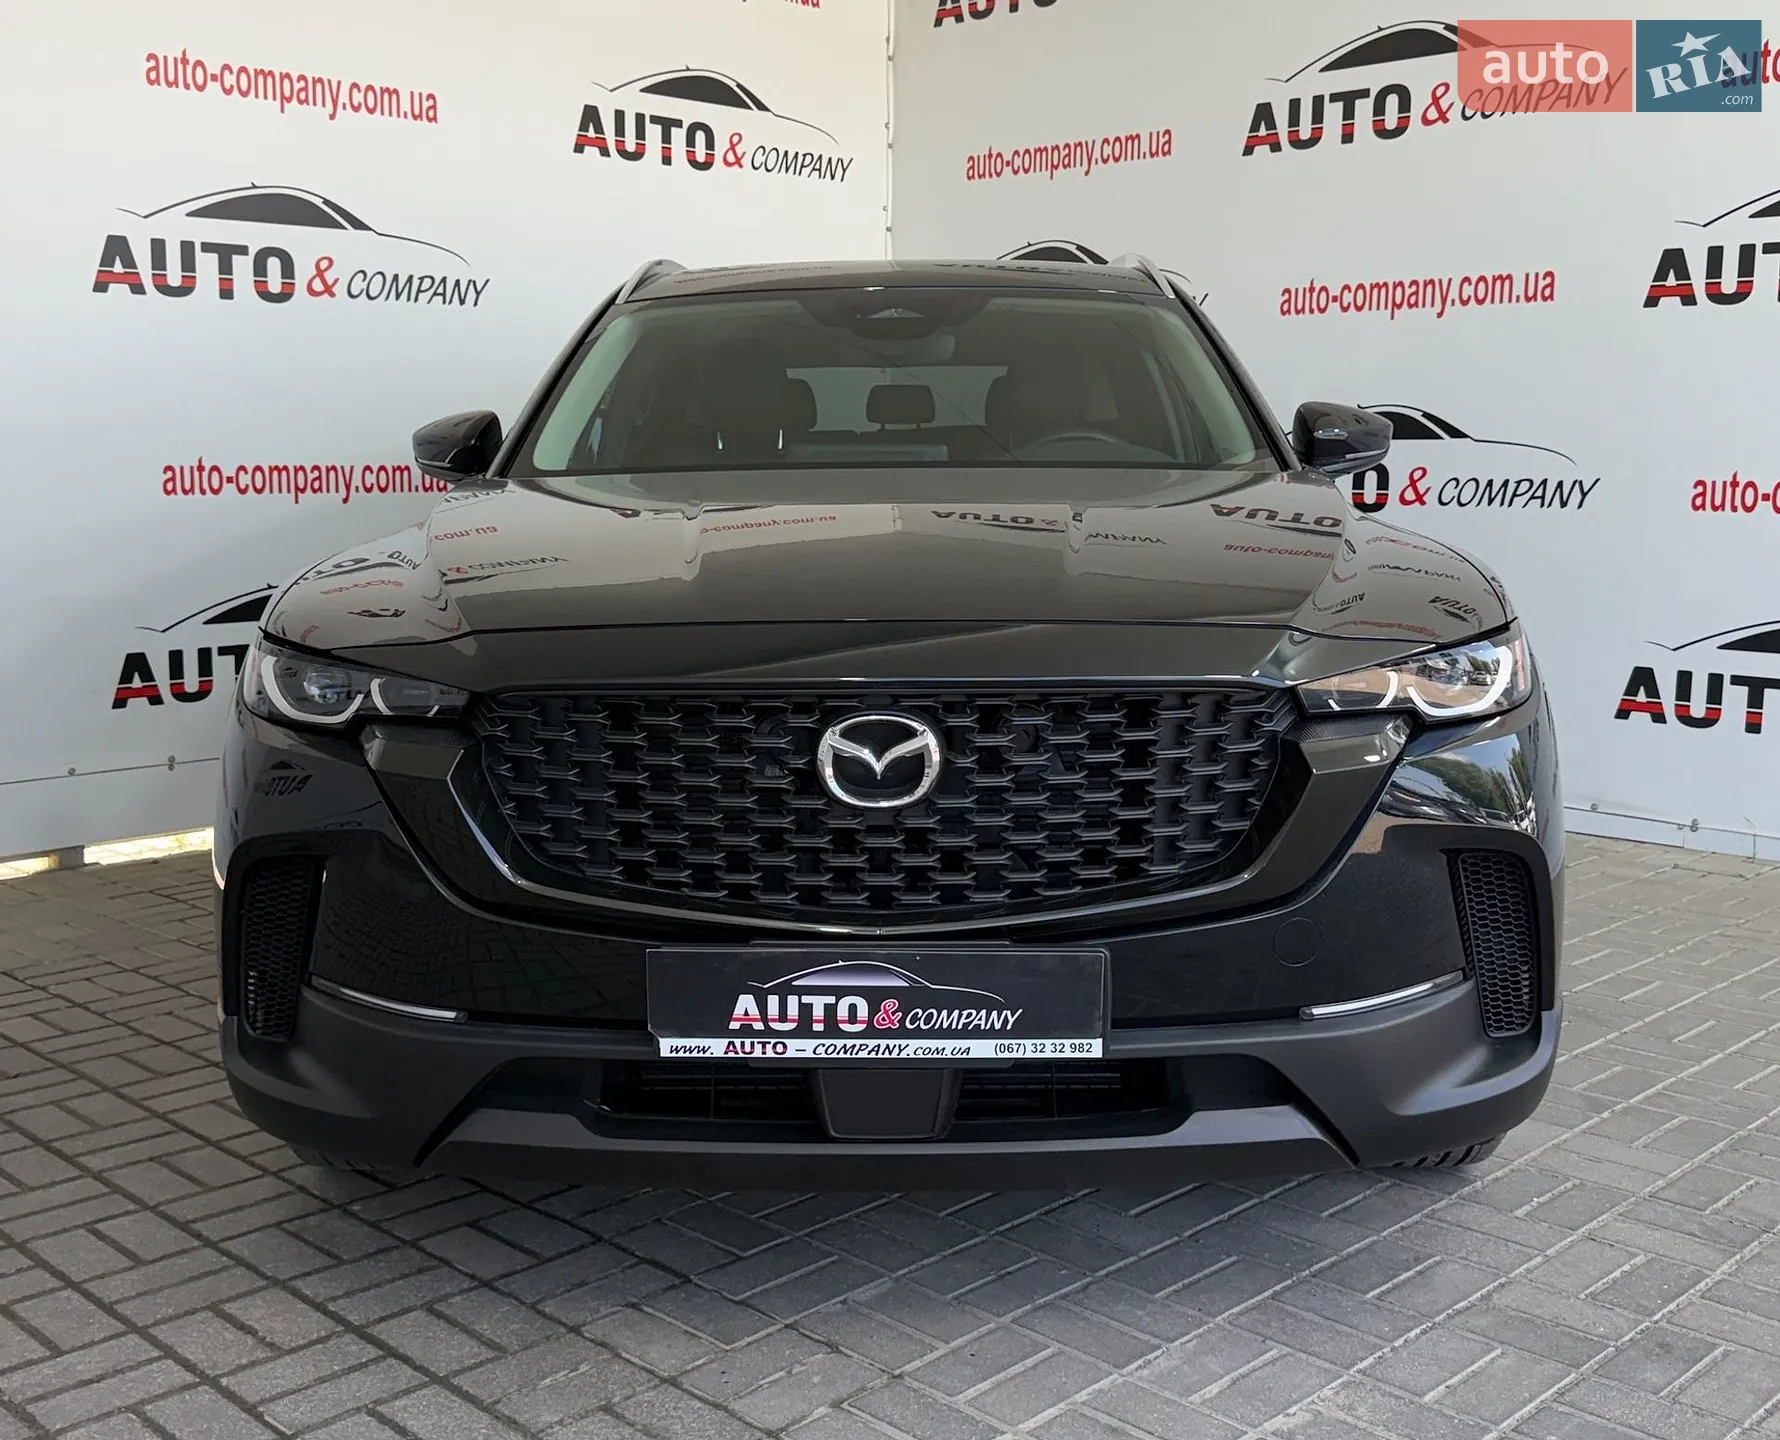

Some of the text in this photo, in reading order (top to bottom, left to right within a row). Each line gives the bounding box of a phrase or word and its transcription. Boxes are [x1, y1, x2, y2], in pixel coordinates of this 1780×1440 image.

[145, 48, 439, 123] auto-company.com.ua
[1242, 67, 1628, 156] AUTO & COMPANY
[573, 104, 854, 182] AUTO & COMPANY
[966, 129, 1173, 181] auto-company.com.ua
[92, 234, 490, 308] AUTO & COMPANY
[1280, 270, 1556, 320] auto-company.com.ua
[1398, 466, 1430, 507] &
[1437, 477, 1601, 510] COMPANY
[728, 994, 1023, 1033] AUTO & COMPANY
[723, 1040, 788, 1056] AUTO
[994, 1042, 1027, 1056] (067)
[1030, 1043, 1047, 1054] 32
[1050, 1043, 1066, 1054] 32
[1070, 1042, 1094, 1054] 982
